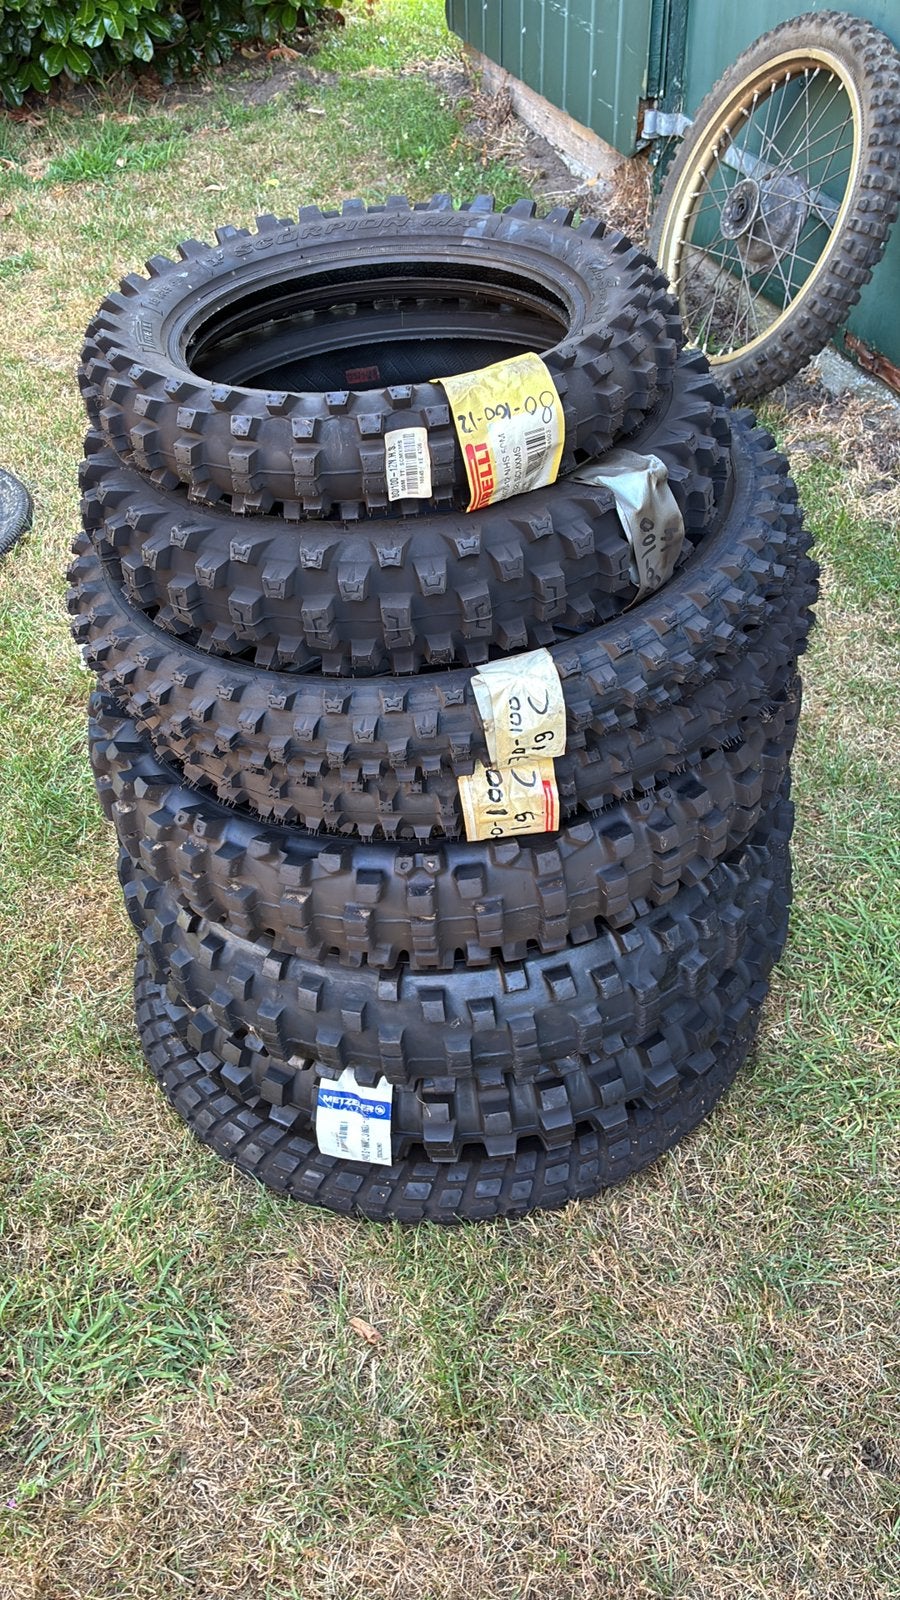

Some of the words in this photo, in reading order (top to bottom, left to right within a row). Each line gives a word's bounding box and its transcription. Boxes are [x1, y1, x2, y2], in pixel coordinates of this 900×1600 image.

[234, 216, 411, 258] SCORPION
[502, 455, 511, 476] NHS
[527, 688, 550, 715] C
[532, 730, 555, 750] 19
[510, 769, 537, 788] C
[485, 769, 509, 838] 0-100
[511, 811, 535, 830] 19
